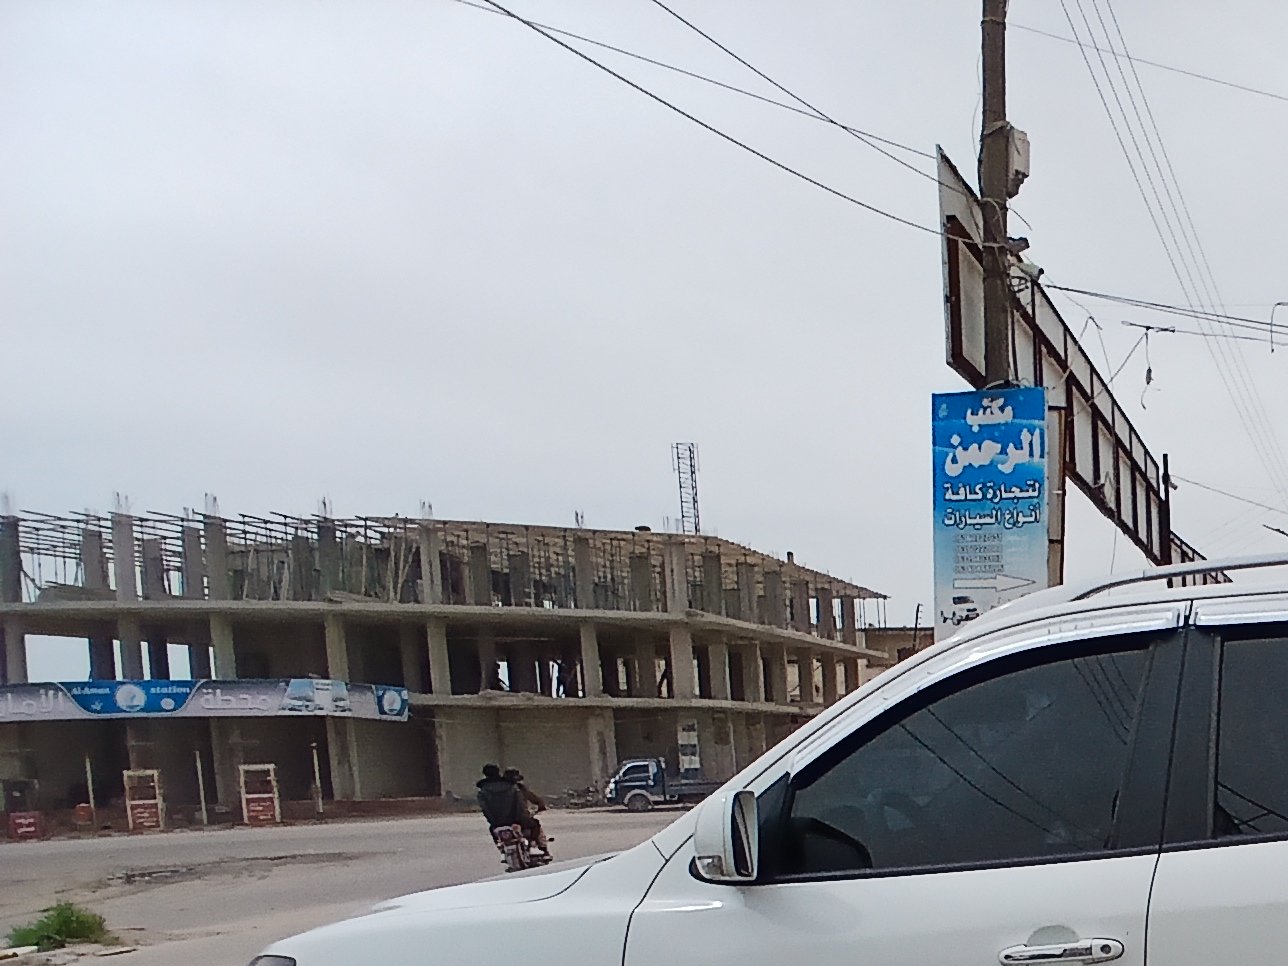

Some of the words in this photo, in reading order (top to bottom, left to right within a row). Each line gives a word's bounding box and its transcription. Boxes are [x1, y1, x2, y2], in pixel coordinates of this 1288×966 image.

[966, 397, 1014, 432] مكتب
[944, 428, 1040, 477] الرحمن
[943, 483, 983, 501] كافة
[987, 481, 1040, 503] لتجارة
[943, 508, 1000, 529] السيارات
[1004, 503, 1040, 529] أنواع
